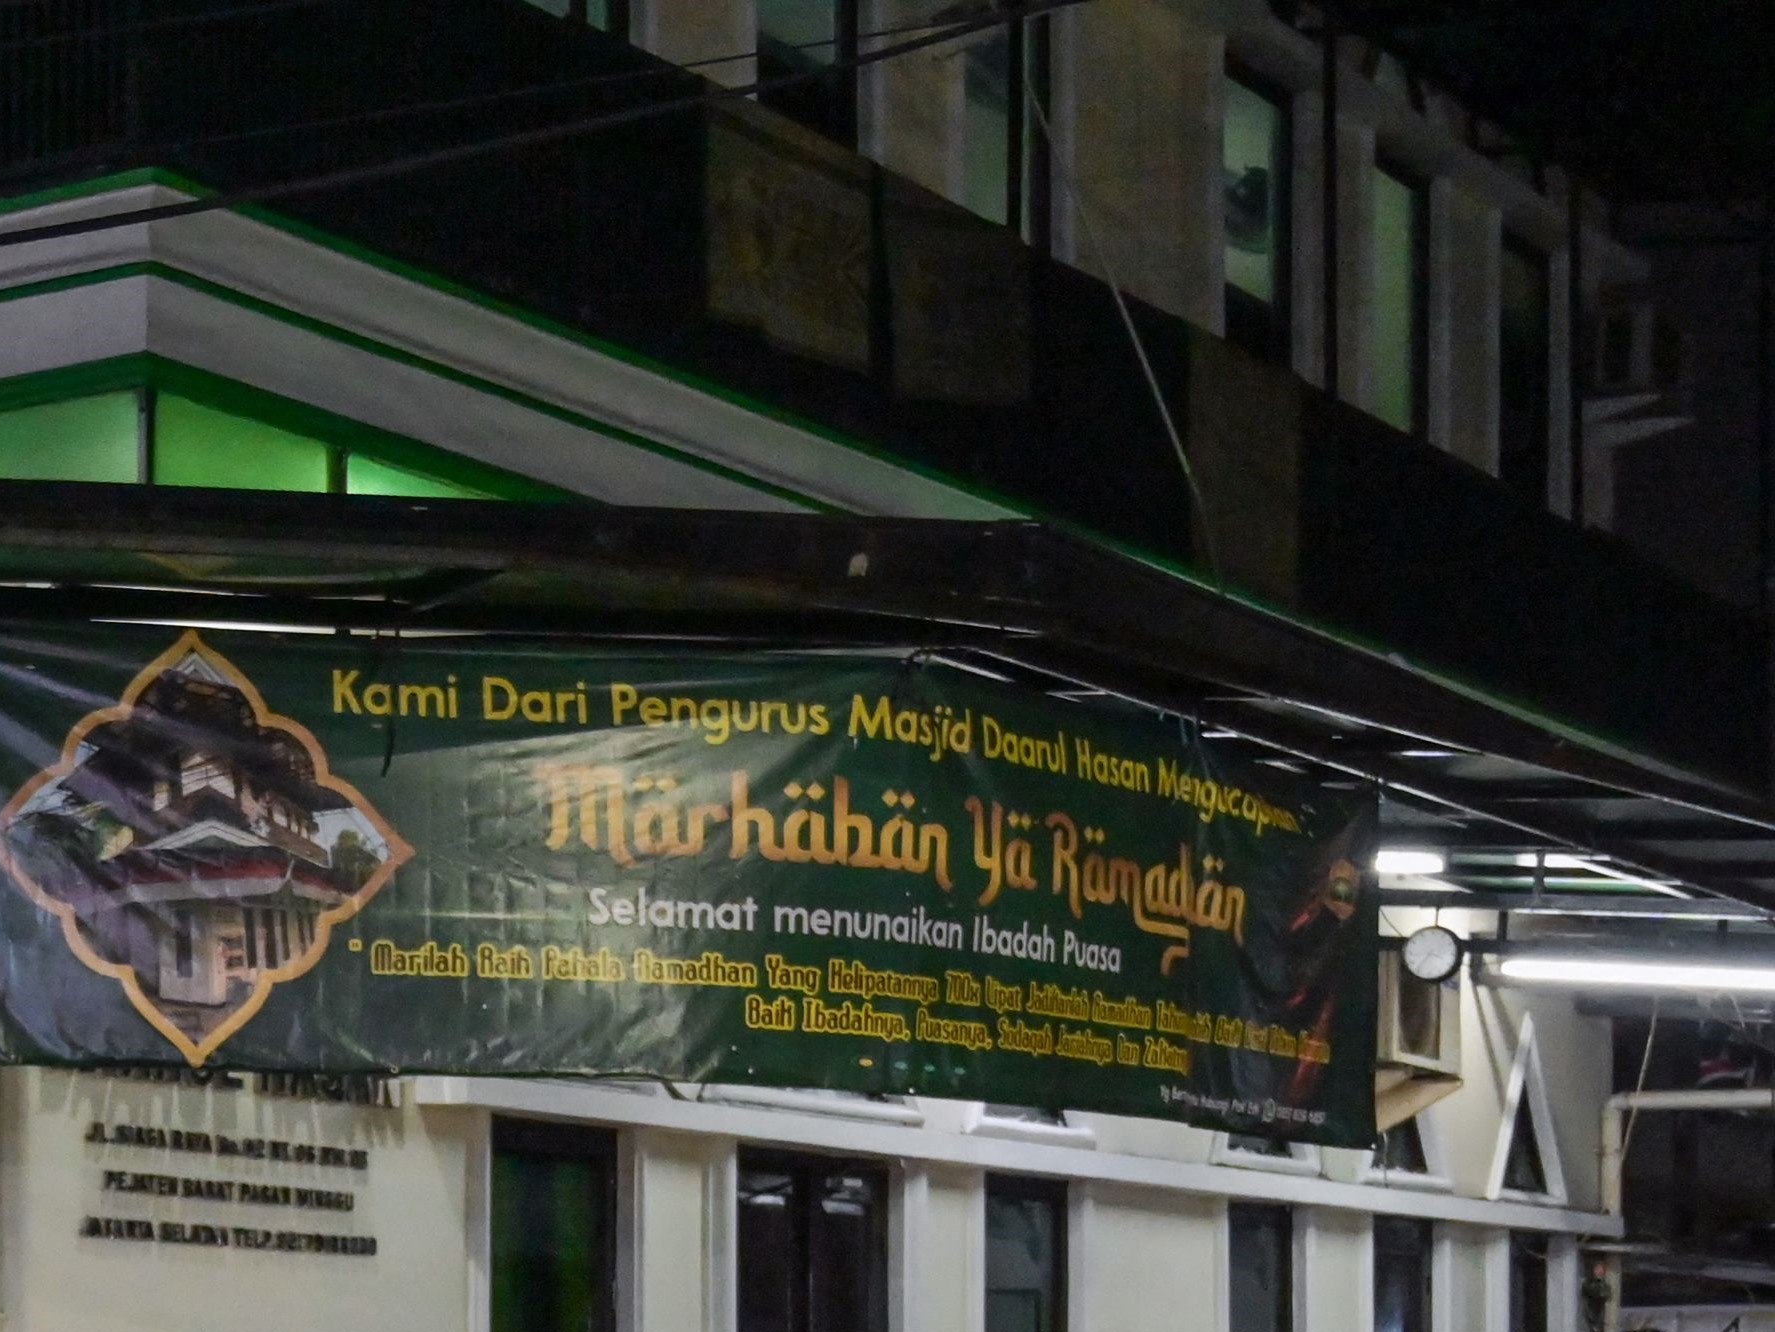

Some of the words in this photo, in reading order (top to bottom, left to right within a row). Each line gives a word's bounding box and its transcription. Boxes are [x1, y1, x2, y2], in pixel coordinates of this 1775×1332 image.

[332, 669, 459, 718] Kami
[482, 676, 587, 724] Dari
[611, 682, 830, 745] Pengurus
[848, 694, 972, 762] Masjid
[982, 714, 1067, 774] Daarul
[1076, 737, 1150, 793] Hasan
[589, 887, 758, 932] Selamat
[773, 905, 963, 949] menunaikan
[972, 914, 1056, 963] Ibadah
[1063, 930, 1122, 973] Puasa
[372, 938, 470, 977] Marilah
[477, 942, 533, 979] Raih
[634, 948, 758, 987] Ramadhan
[765, 954, 822, 995] Yang
[745, 994, 795, 1031] Baik
[802, 997, 911, 1042] Ibadahnya,
